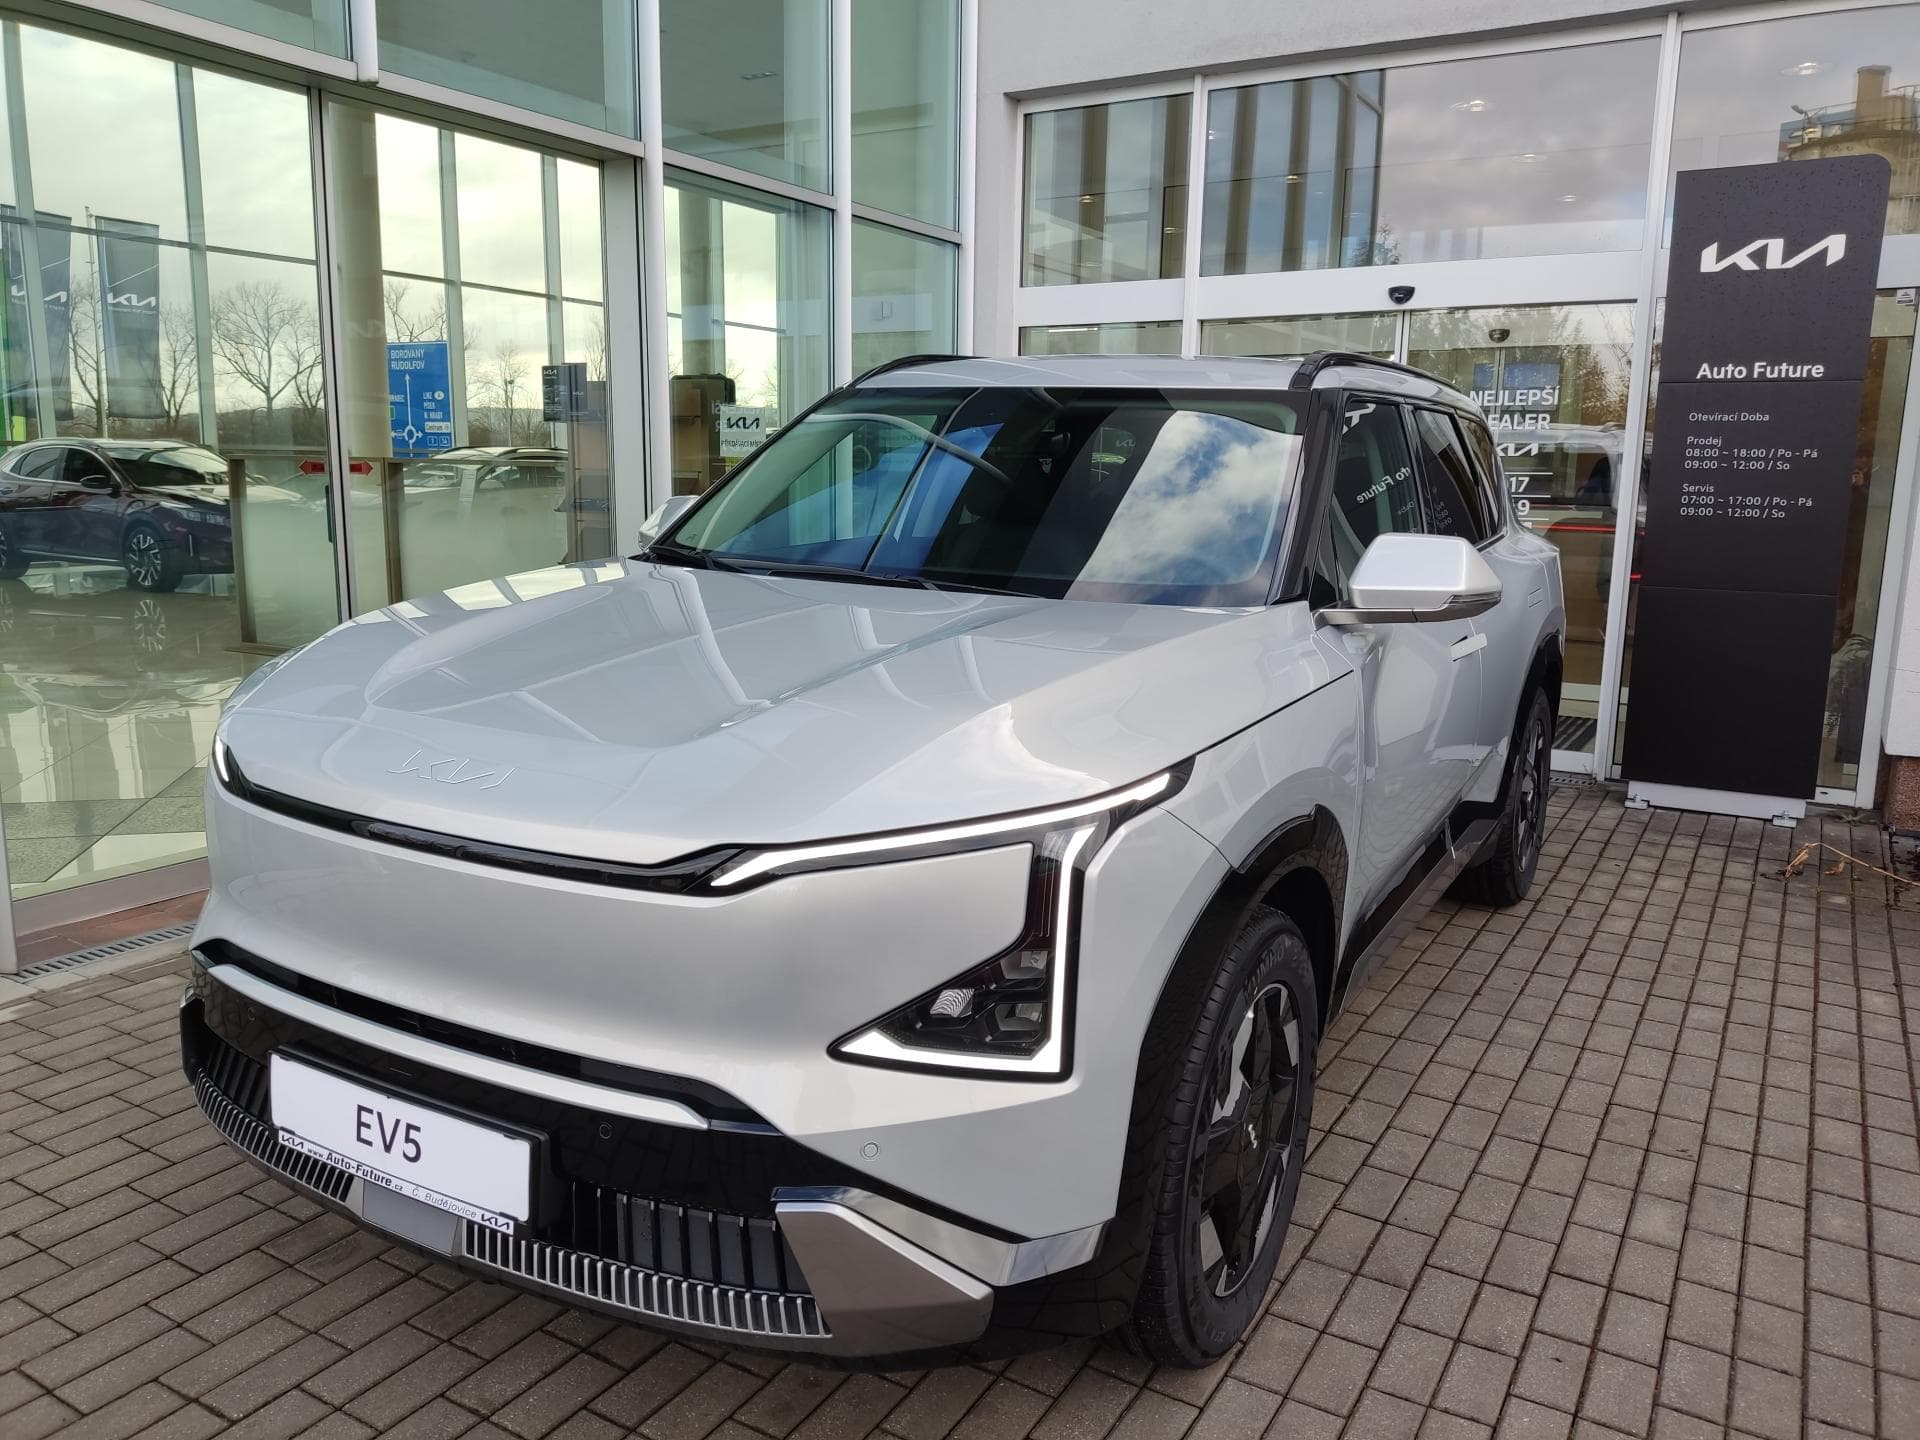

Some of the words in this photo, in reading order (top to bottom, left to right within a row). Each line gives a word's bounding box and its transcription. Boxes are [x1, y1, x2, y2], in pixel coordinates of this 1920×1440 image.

[1700, 234, 1847, 272] KIA
[107, 292, 156, 308] KIA
[390, 349, 425, 359] BOROVANY
[391, 361, 425, 370] RUDOLFOV
[1696, 363, 1747, 379] Auto
[1753, 362, 1825, 378] Future
[1470, 386, 1561, 406] NEJLEPŠÍ
[726, 416, 760, 430] KIA
[1488, 413, 1551, 430] EALER
[1688, 412, 1738, 421] Otevírací
[1740, 412, 1770, 421] Doba
[1687, 436, 1722, 447] Prodej
[1685, 448, 1719, 457] 08:00
[1733, 448, 1766, 457] 18:00
[1777, 449, 1792, 458] Po
[1803, 449, 1818, 458] Pá
[1684, 460, 1718, 469] 09:00
[1732, 461, 1765, 469] 12:00
[1776, 461, 1790, 470] So
[1509, 476, 1530, 493] 17
[1682, 483, 1715, 493] Servis
[1681, 495, 1714, 504] 07:00
[1729, 496, 1761, 505] 17:00
[1772, 497, 1787, 506] Po
[1798, 497, 1813, 507] Pá
[1680, 507, 1713, 516] 09:00
[1727, 508, 1760, 517] 12:00
[1771, 509, 1785, 518] So
[387, 750, 518, 791] KIA
[356, 1104, 422, 1163] EV5
[281, 1134, 304, 1150] KIA
[307, 1148, 403, 1192] www.Auto-Future.cz
[424, 1192, 477, 1219] Budějovice
[481, 1213, 510, 1231] KIA
